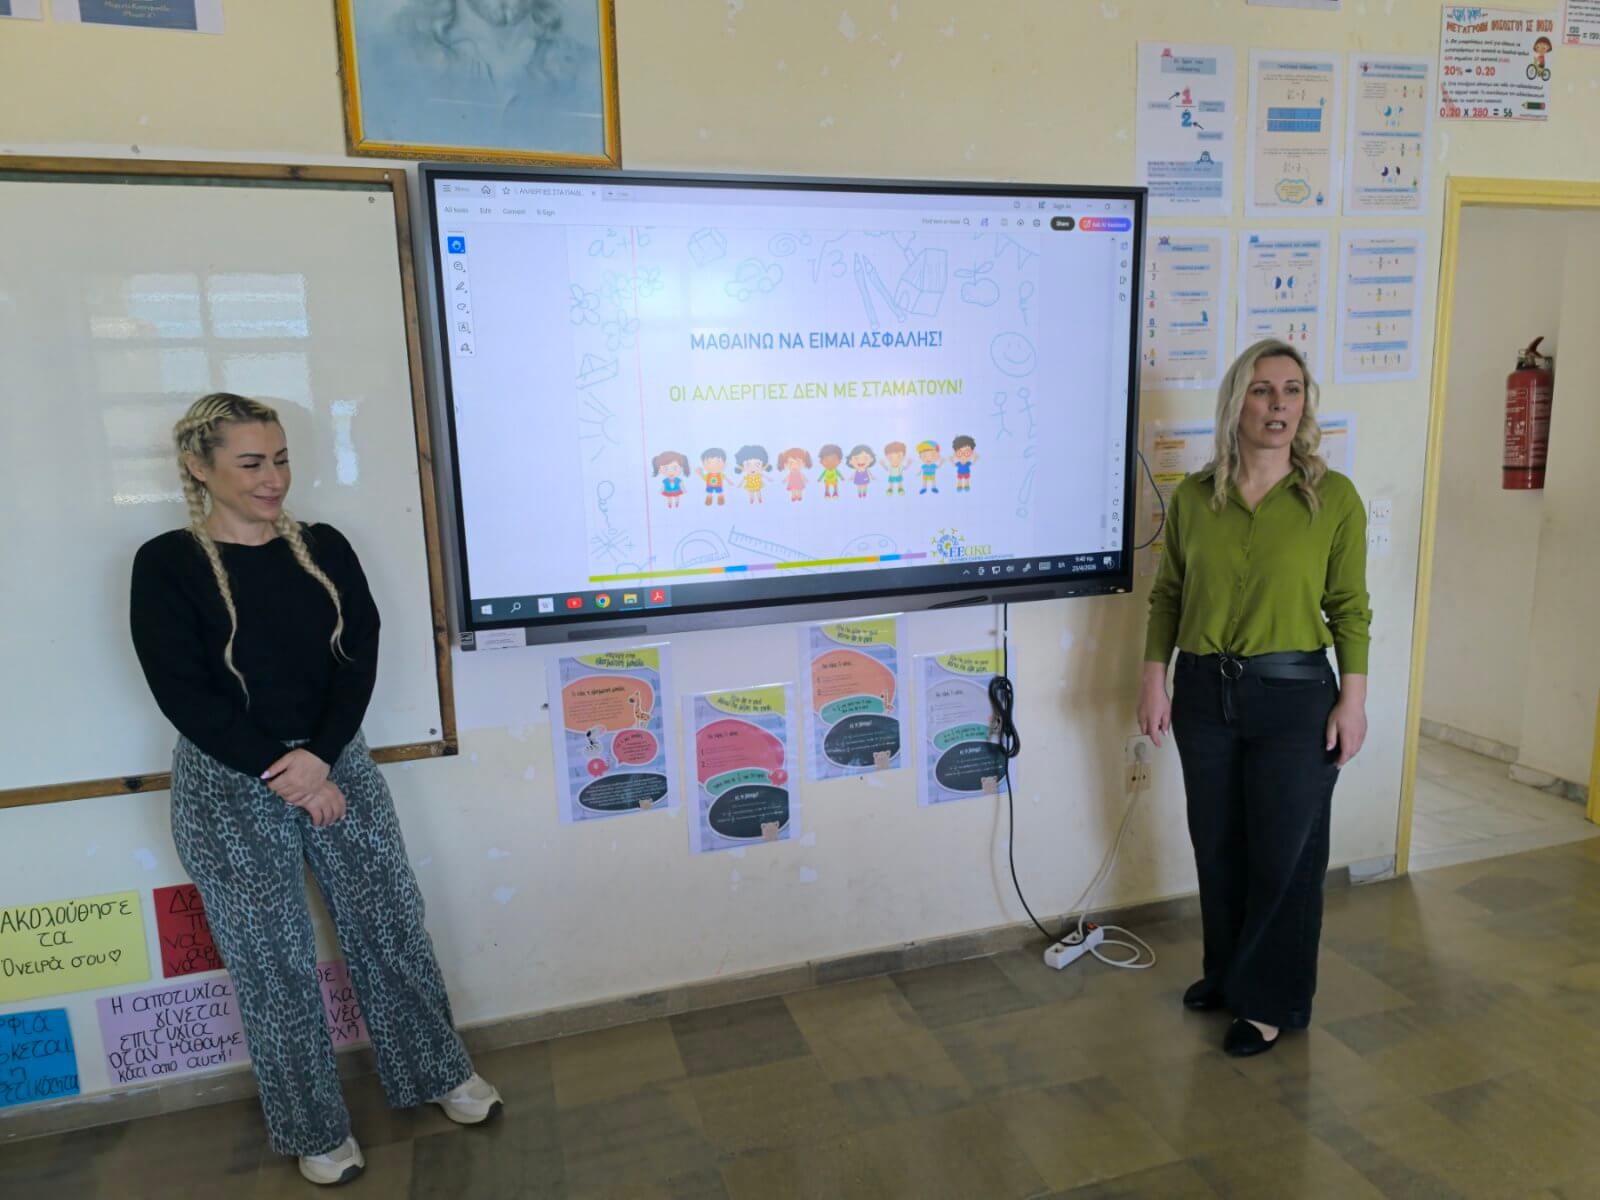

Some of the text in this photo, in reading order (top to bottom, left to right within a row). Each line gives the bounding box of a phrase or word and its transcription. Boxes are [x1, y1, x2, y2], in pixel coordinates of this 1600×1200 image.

[1444, 65, 1496, 76] 20% 0.20
[1182, 87, 1192, 105] 1
[1181, 111, 1192, 127] 2
[1440, 107, 1461, 118] 0.20
[1503, 107, 1513, 118] 56
[690, 331, 943, 351] ΜΑΘΑΙΝΩ ΝΑ ΕΙΜΑΙ ΑΣΦΑΛΗΣ!
[669, 378, 963, 402] ΟΙ ΑΛΛΕΡΓΙΕΣ ΔΕΝ ΜΕ ΣΤΑΜΑΤΟΥΝ!
[38, 931, 73, 947] τα
[111, 997, 123, 1015] Η
